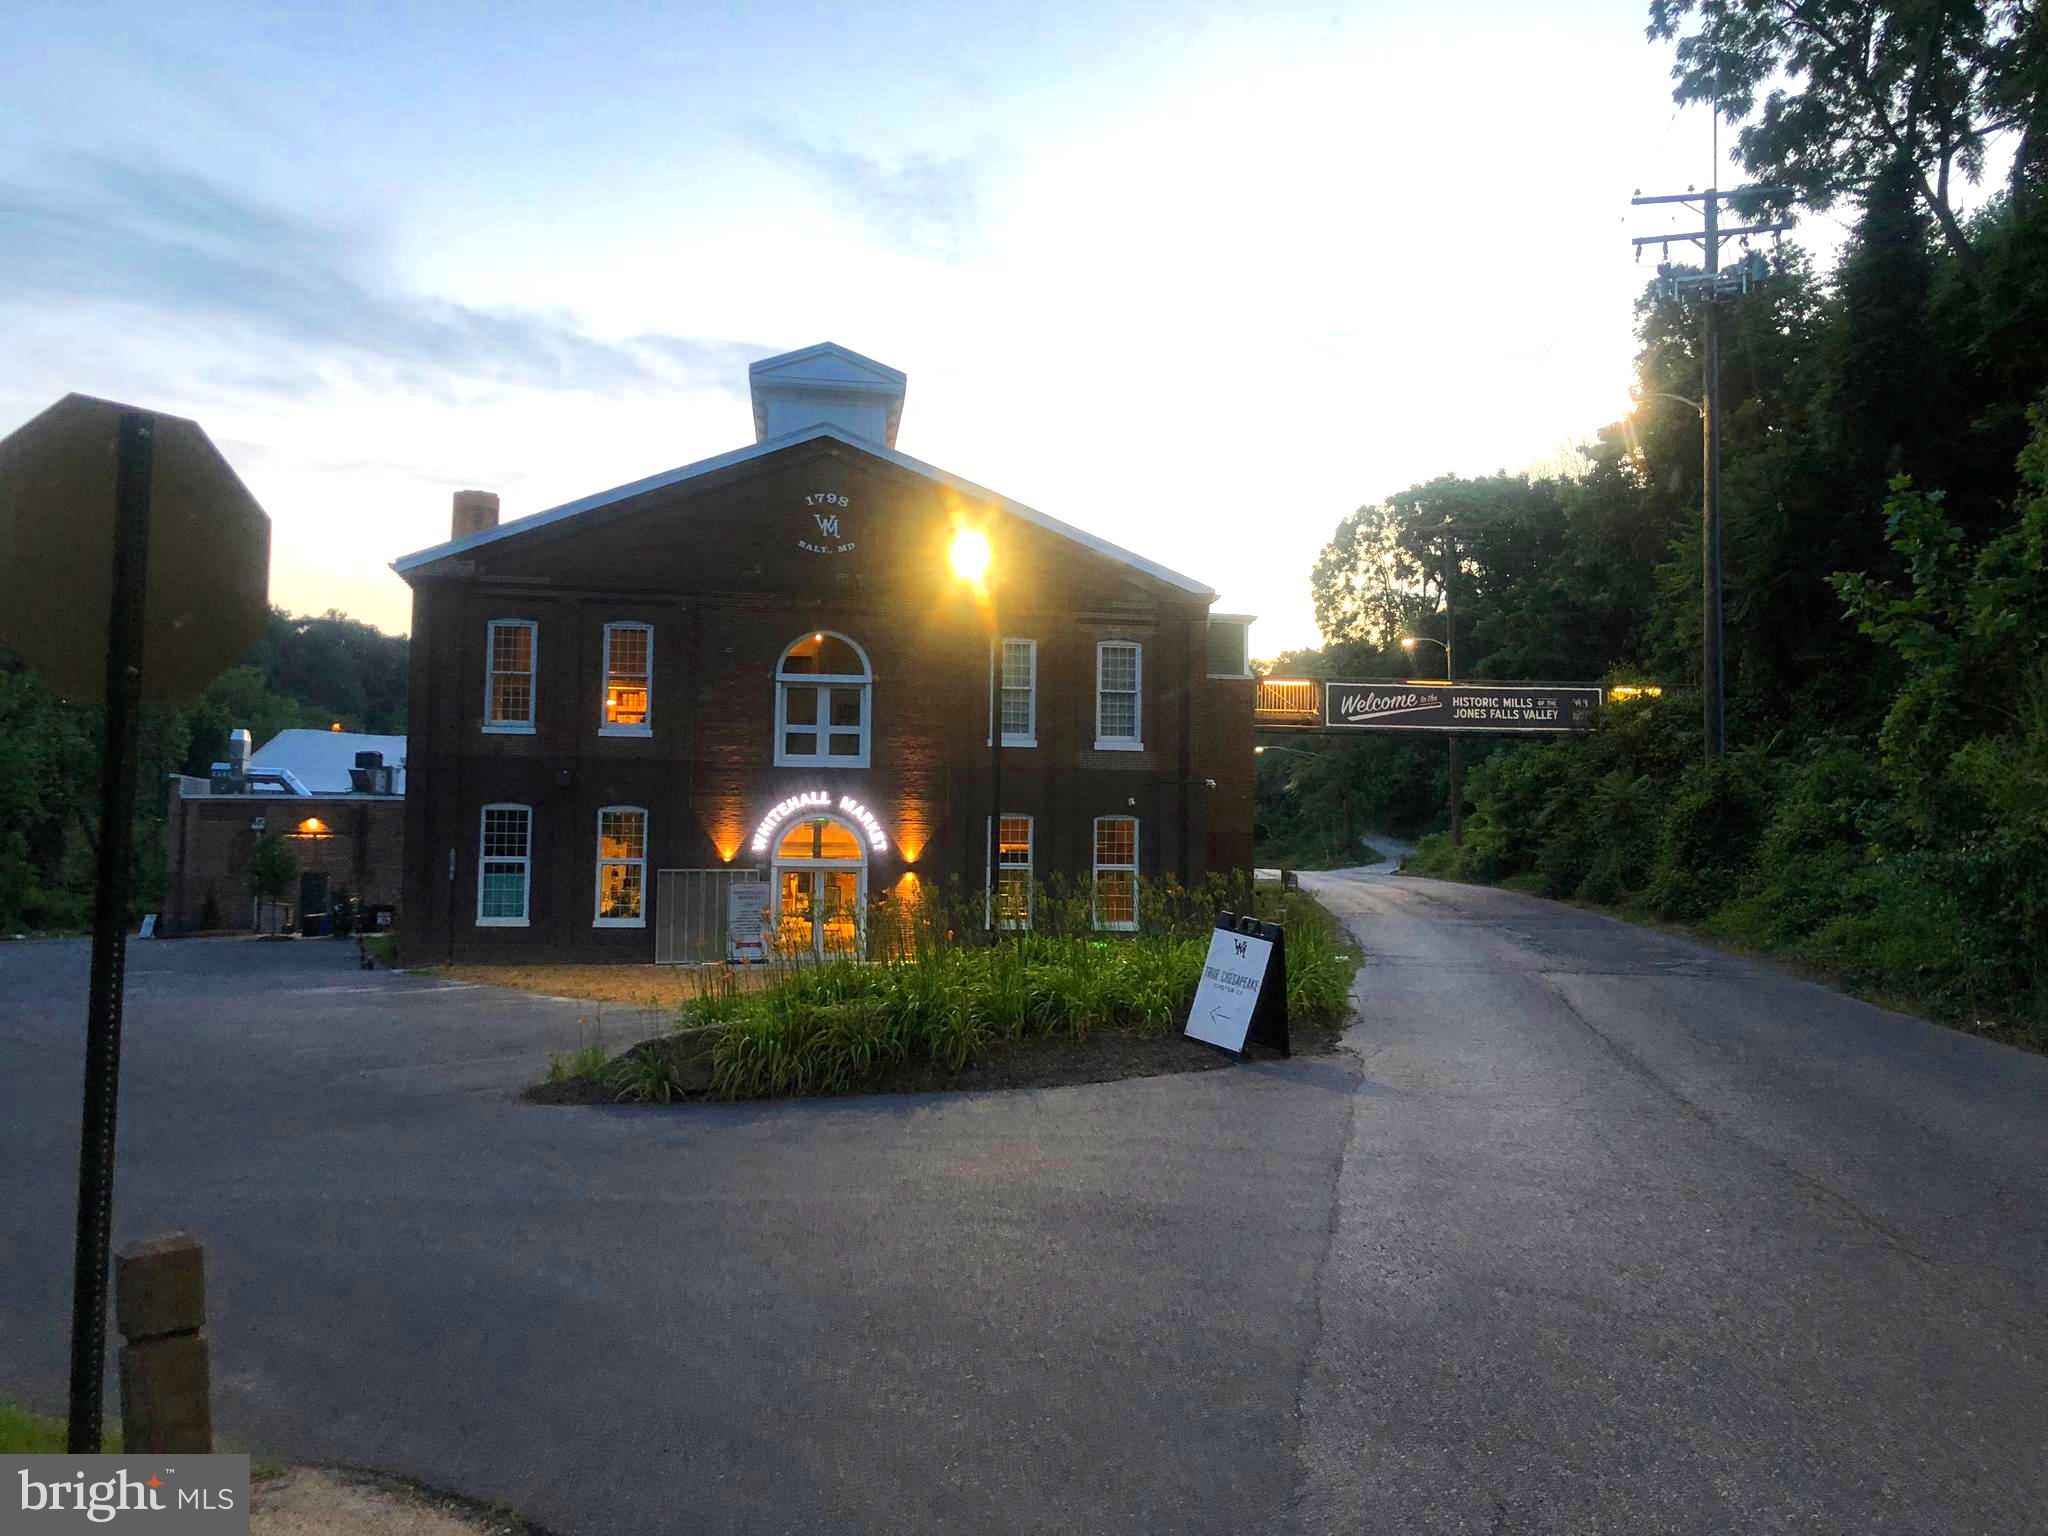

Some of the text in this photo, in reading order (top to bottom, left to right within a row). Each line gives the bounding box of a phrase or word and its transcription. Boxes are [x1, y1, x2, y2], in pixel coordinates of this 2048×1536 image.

[805, 493, 849, 507] 1798
[1341, 692, 1438, 714] Welcome to the
[1452, 697, 1499, 707] HISTORIC
[1503, 698, 1533, 708] MILLS
[1453, 708, 1559, 720] JONES FALLS VALLEY
[751, 791, 887, 851] WHITEHALL MARKET
[1220, 971, 1259, 992] CHESAPEAKE
